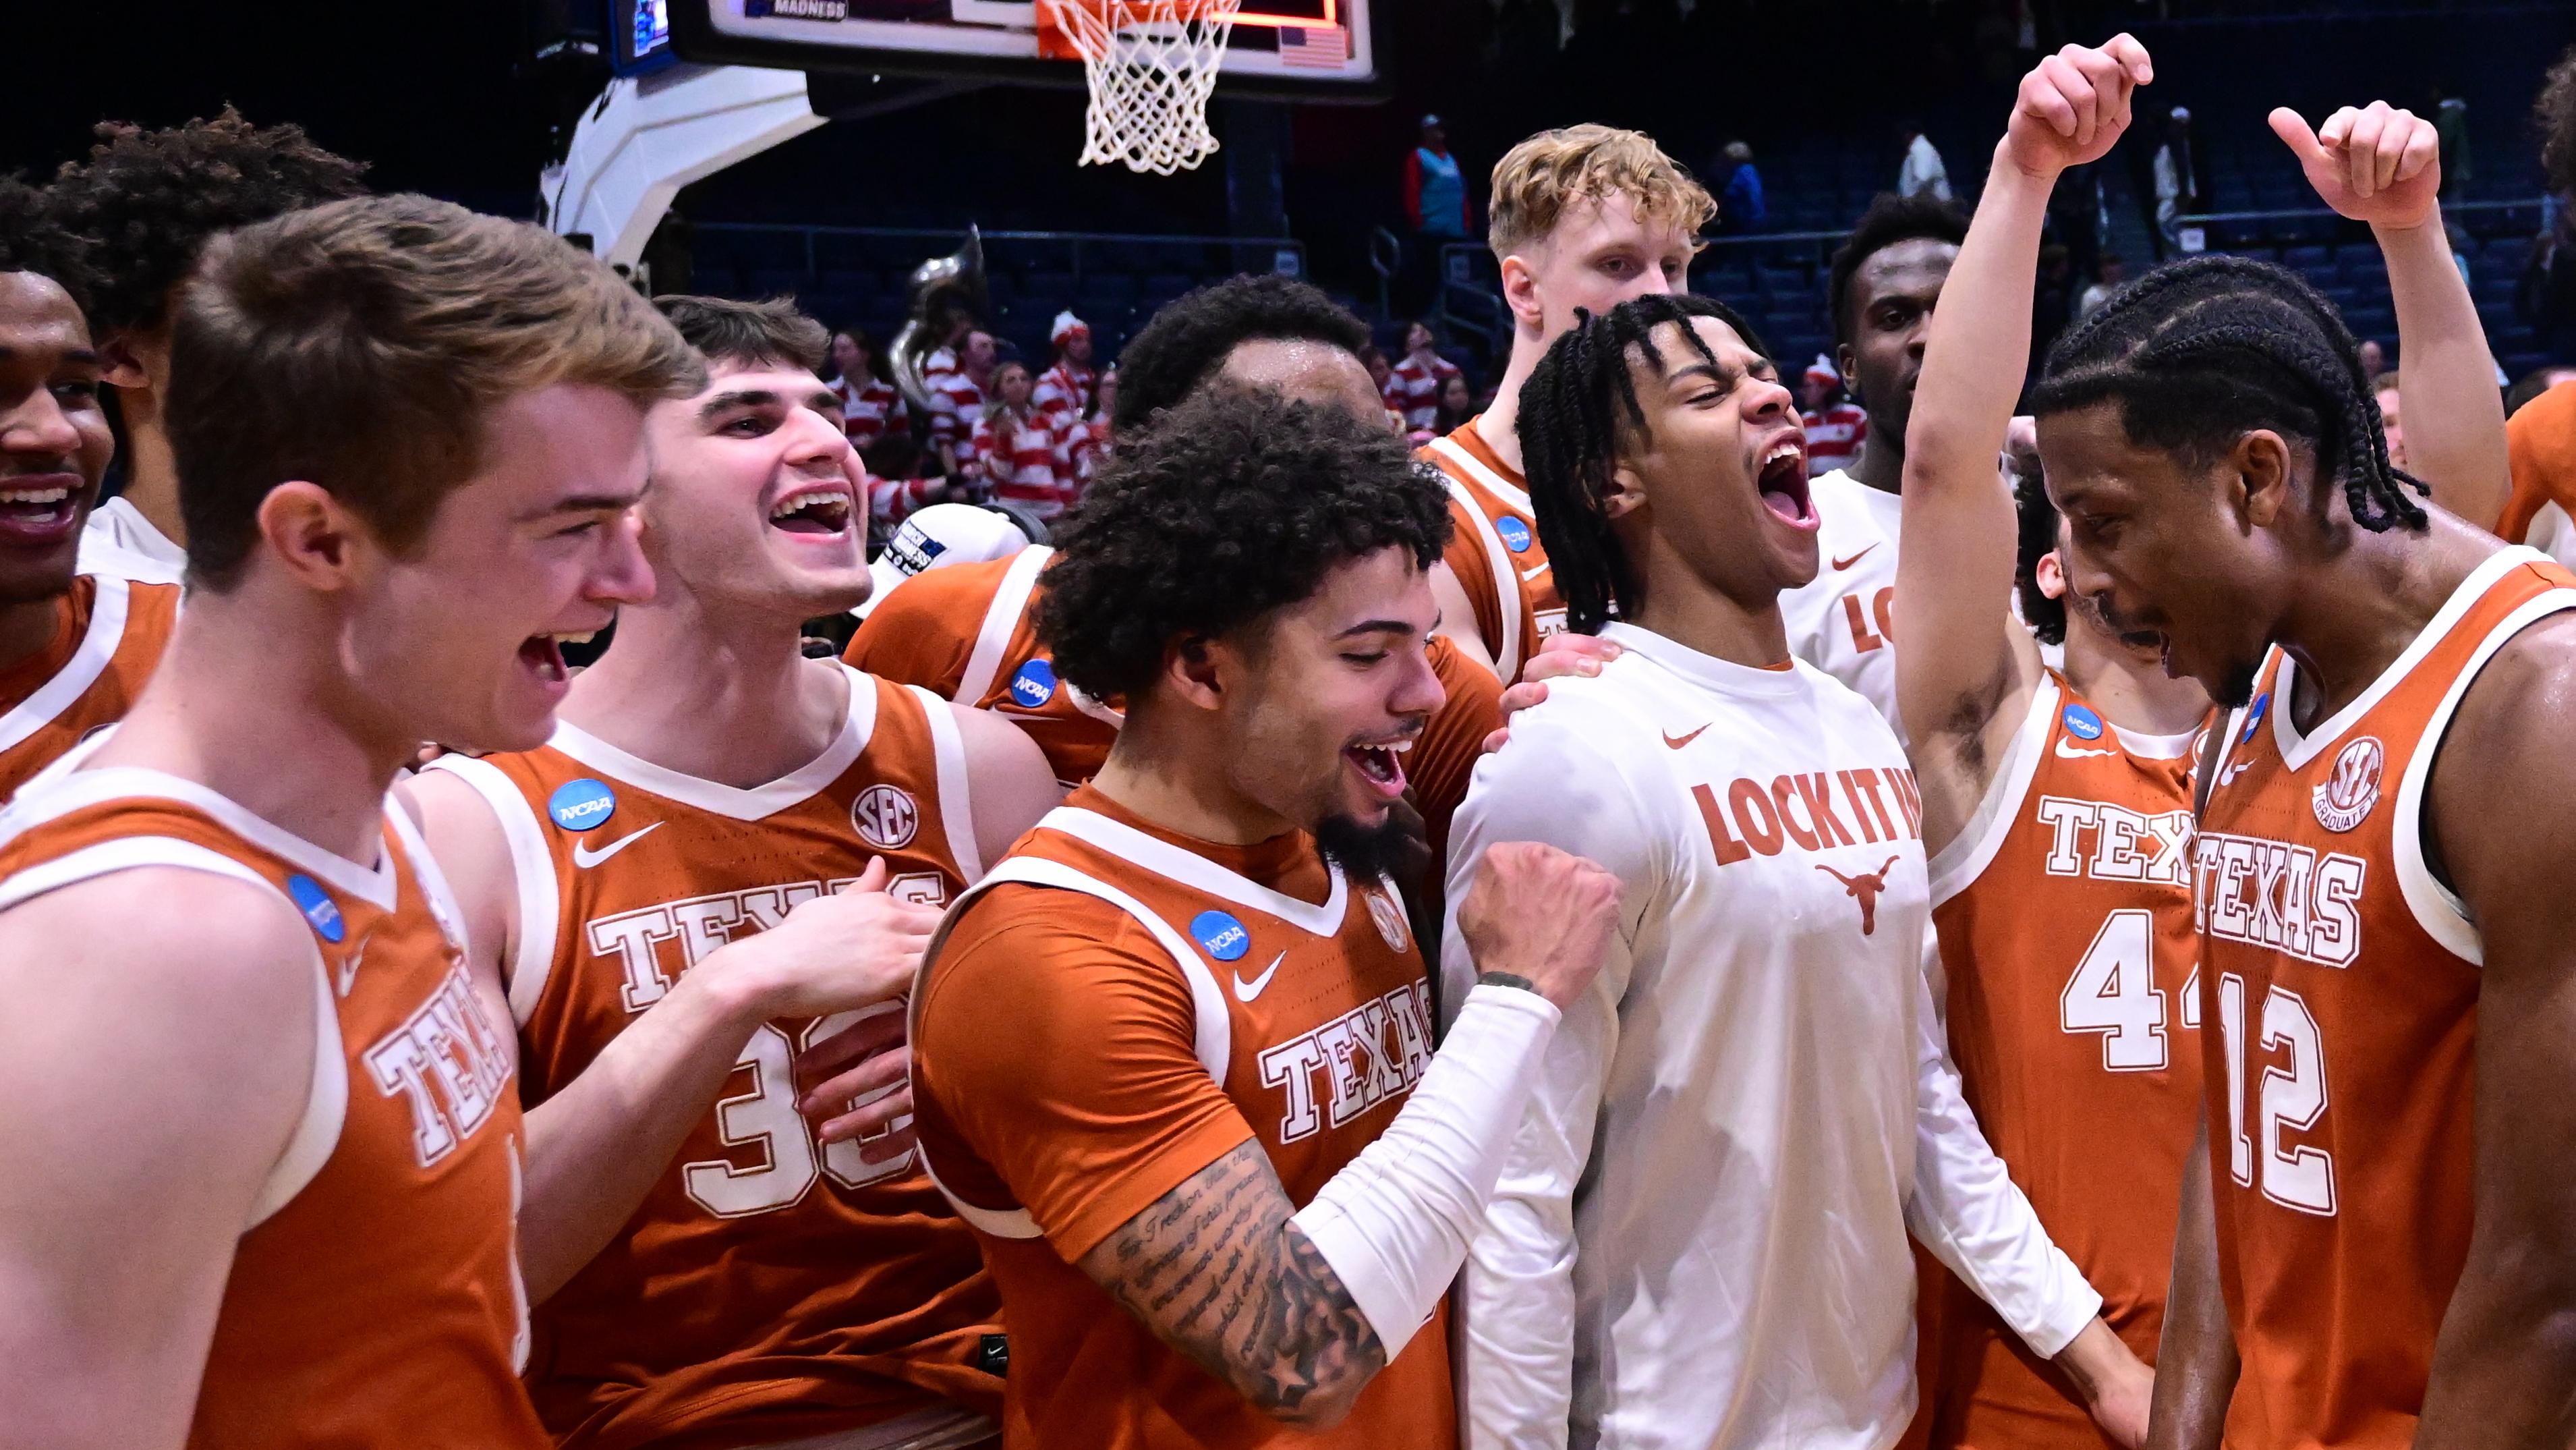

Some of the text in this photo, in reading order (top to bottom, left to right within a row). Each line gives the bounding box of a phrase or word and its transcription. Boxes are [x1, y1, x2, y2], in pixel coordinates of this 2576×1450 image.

[1014, 675, 1050, 700] NCAA
[2067, 715, 2100, 737] NCAA
[2330, 742, 2379, 806] SEC
[560, 797, 612, 821] NCAA
[857, 788, 913, 844] SEC
[1690, 771, 1856, 867] LOCK
[1836, 768, 1897, 843] IT
[2037, 795, 2198, 886] TEX
[2315, 798, 2366, 830] GRADUATE
[2193, 830, 2366, 969] TEXAS
[586, 871, 944, 1013] TEX
[1205, 926, 1245, 953] NCAA
[2060, 908, 2200, 1072] 4
[2217, 972, 2338, 1217] 12
